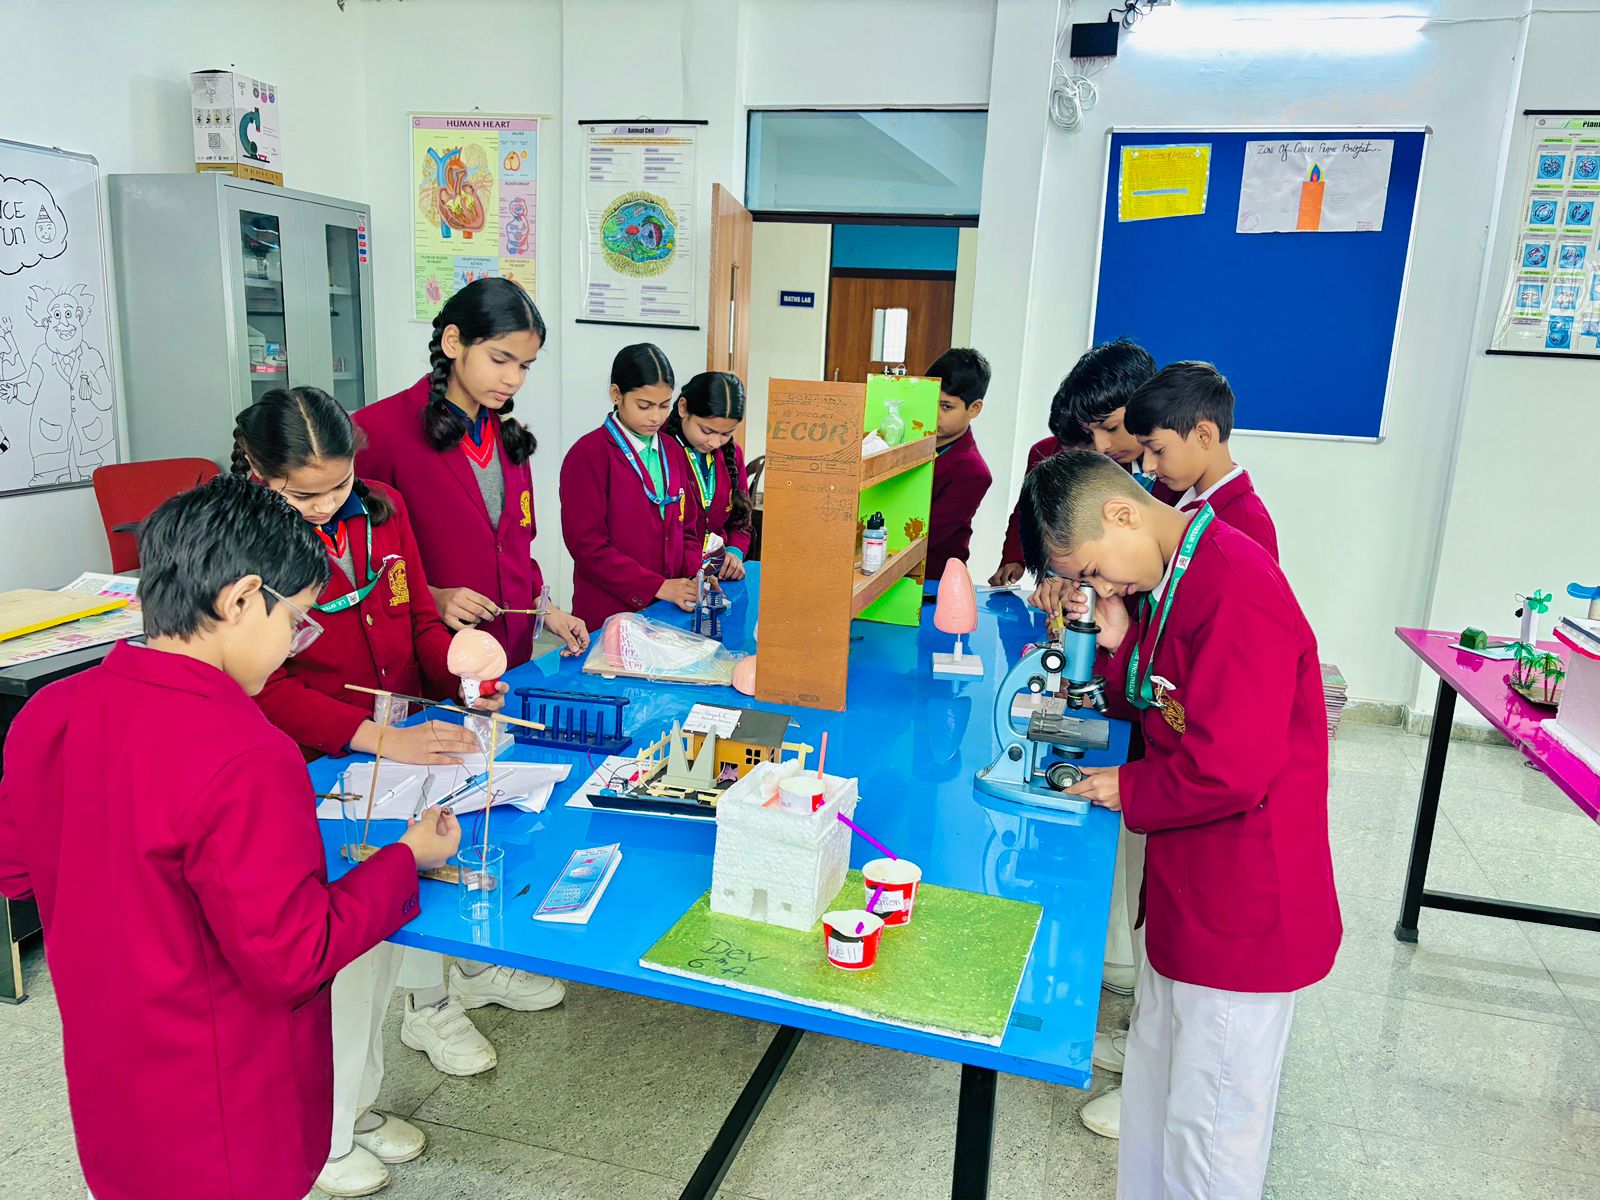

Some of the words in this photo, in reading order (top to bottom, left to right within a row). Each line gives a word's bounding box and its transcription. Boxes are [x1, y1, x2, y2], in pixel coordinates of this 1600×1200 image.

[446, 120, 480, 128] HUMAN
[801, 296, 812, 304] LAB
[700, 937, 769, 963] Dev
[830, 945, 857, 961] Well
